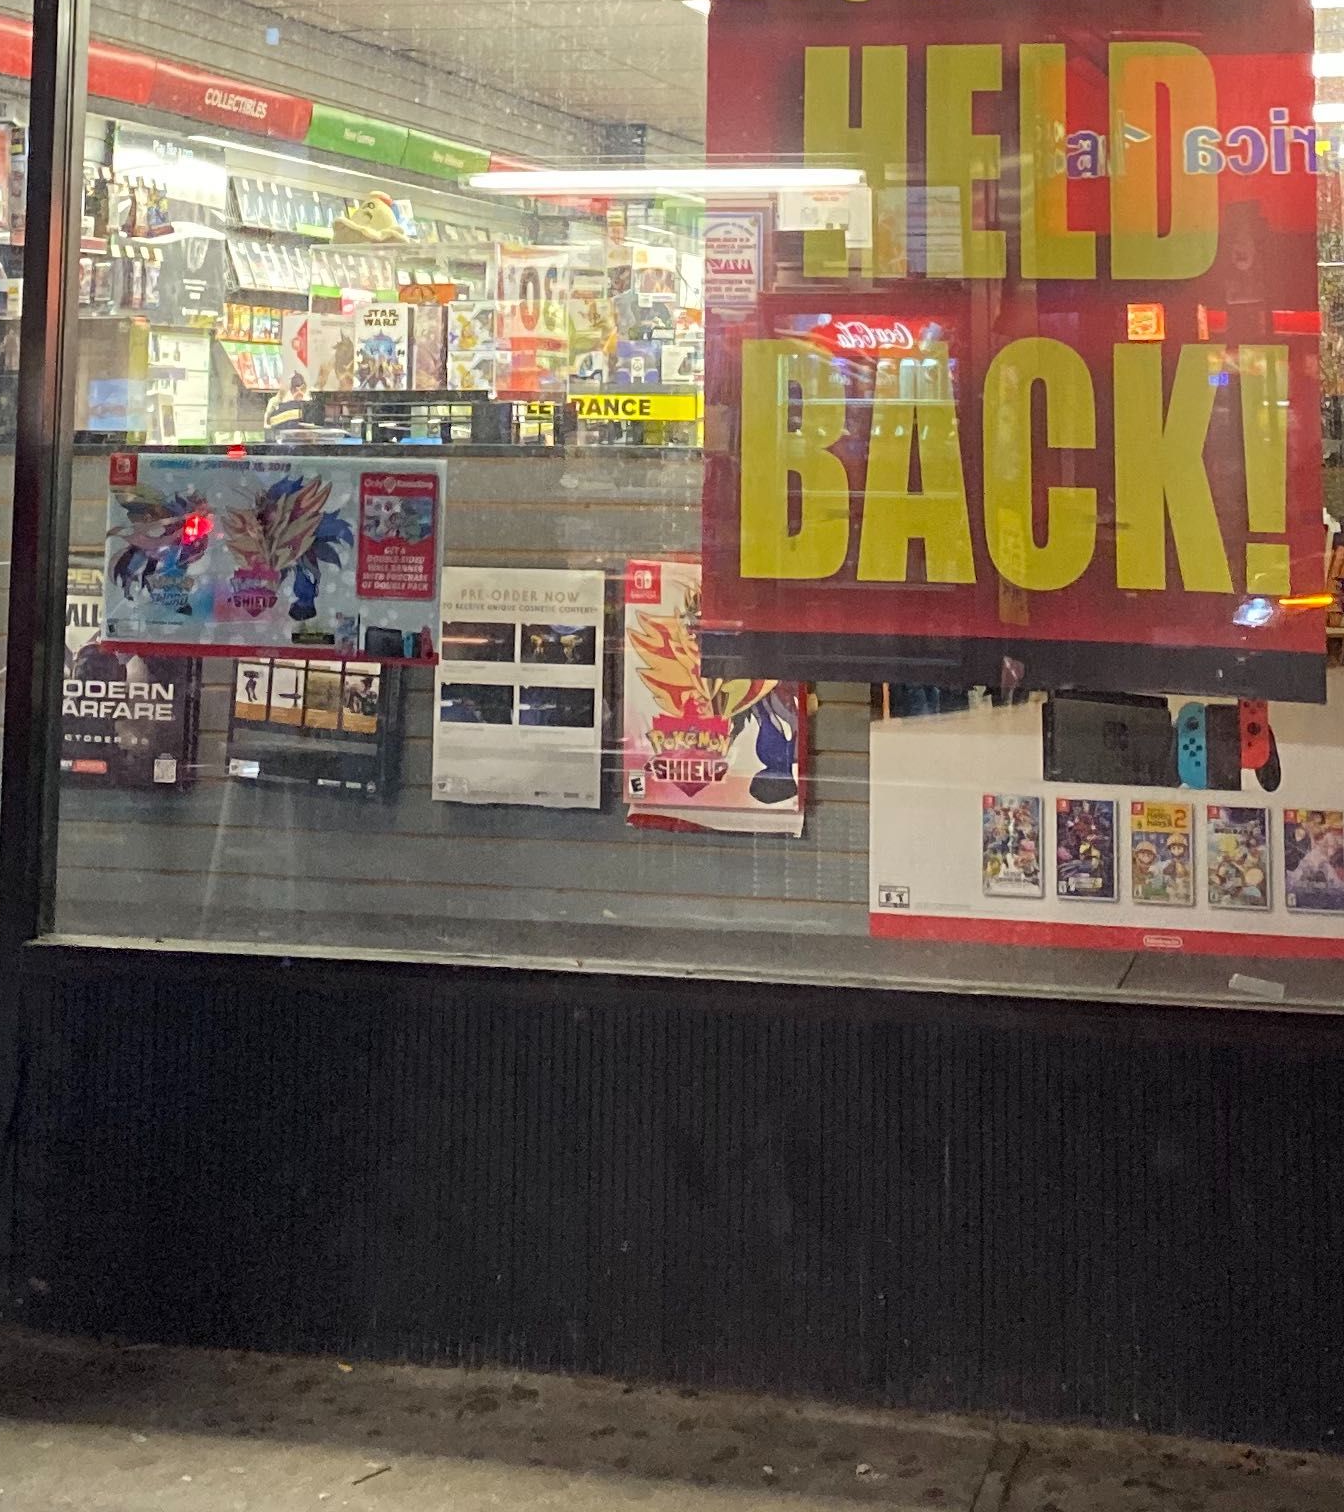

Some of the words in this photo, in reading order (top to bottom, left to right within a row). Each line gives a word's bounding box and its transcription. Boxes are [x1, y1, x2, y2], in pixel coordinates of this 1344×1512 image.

[204, 87, 268, 120] COLLECTIBLES
[803, 41, 1218, 281] HELD
[363, 309, 399, 318] STAR
[363, 318, 399, 327] WARS
[740, 337, 1291, 595] BACK!
[460, 588, 538, 602] PRE-ORDER
[544, 590, 581, 604] NOW
[654, 759, 729, 782] SHIELD
